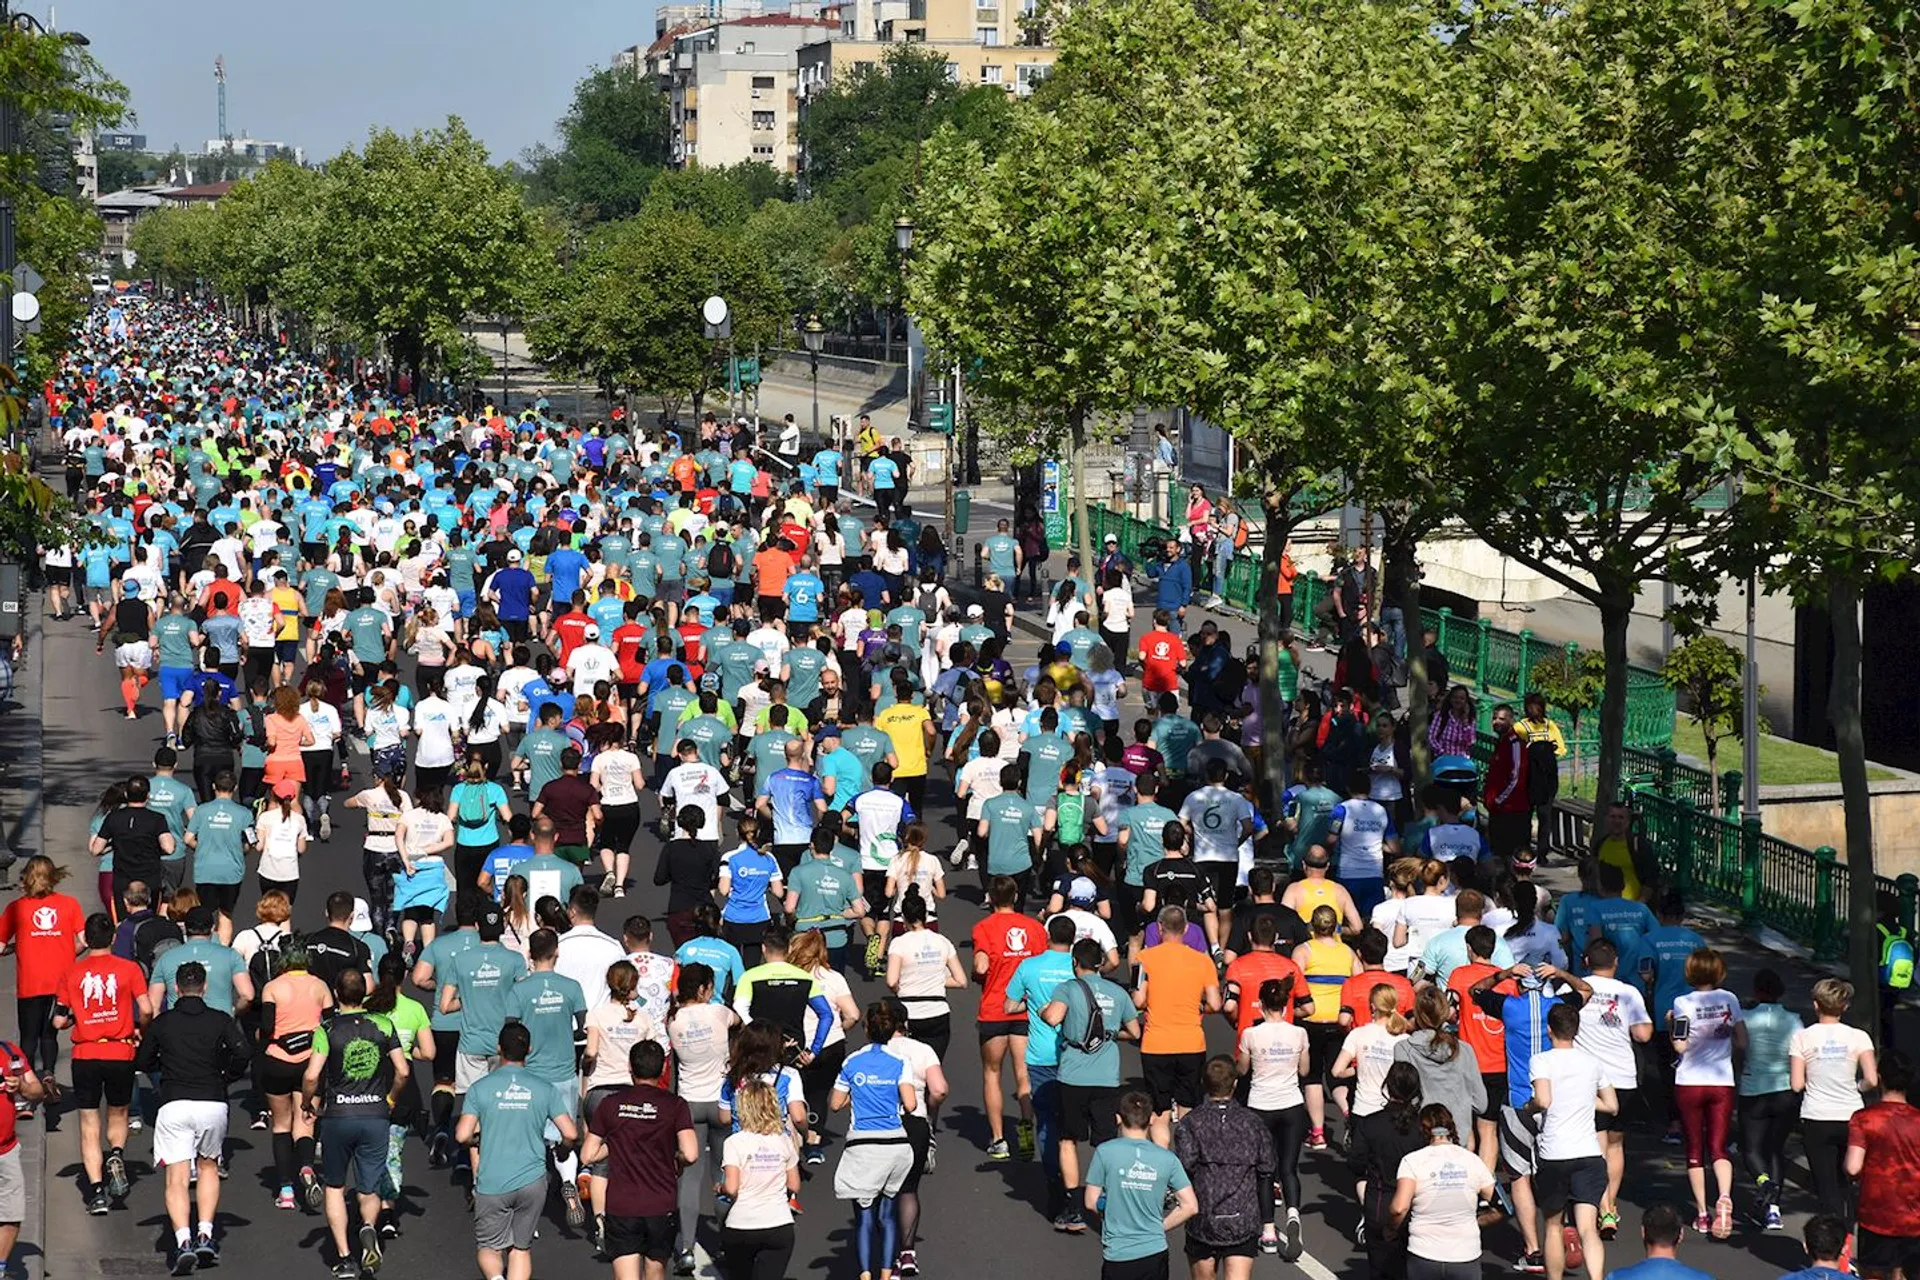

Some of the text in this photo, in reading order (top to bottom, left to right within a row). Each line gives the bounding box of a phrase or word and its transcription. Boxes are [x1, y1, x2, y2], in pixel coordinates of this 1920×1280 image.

[115, 136, 132, 145] IBM
[796, 587, 808, 604] 6
[887, 715, 915, 724] stryker
[1203, 805, 1222, 830] 6
[337, 1094, 382, 1104] Deloitte.
